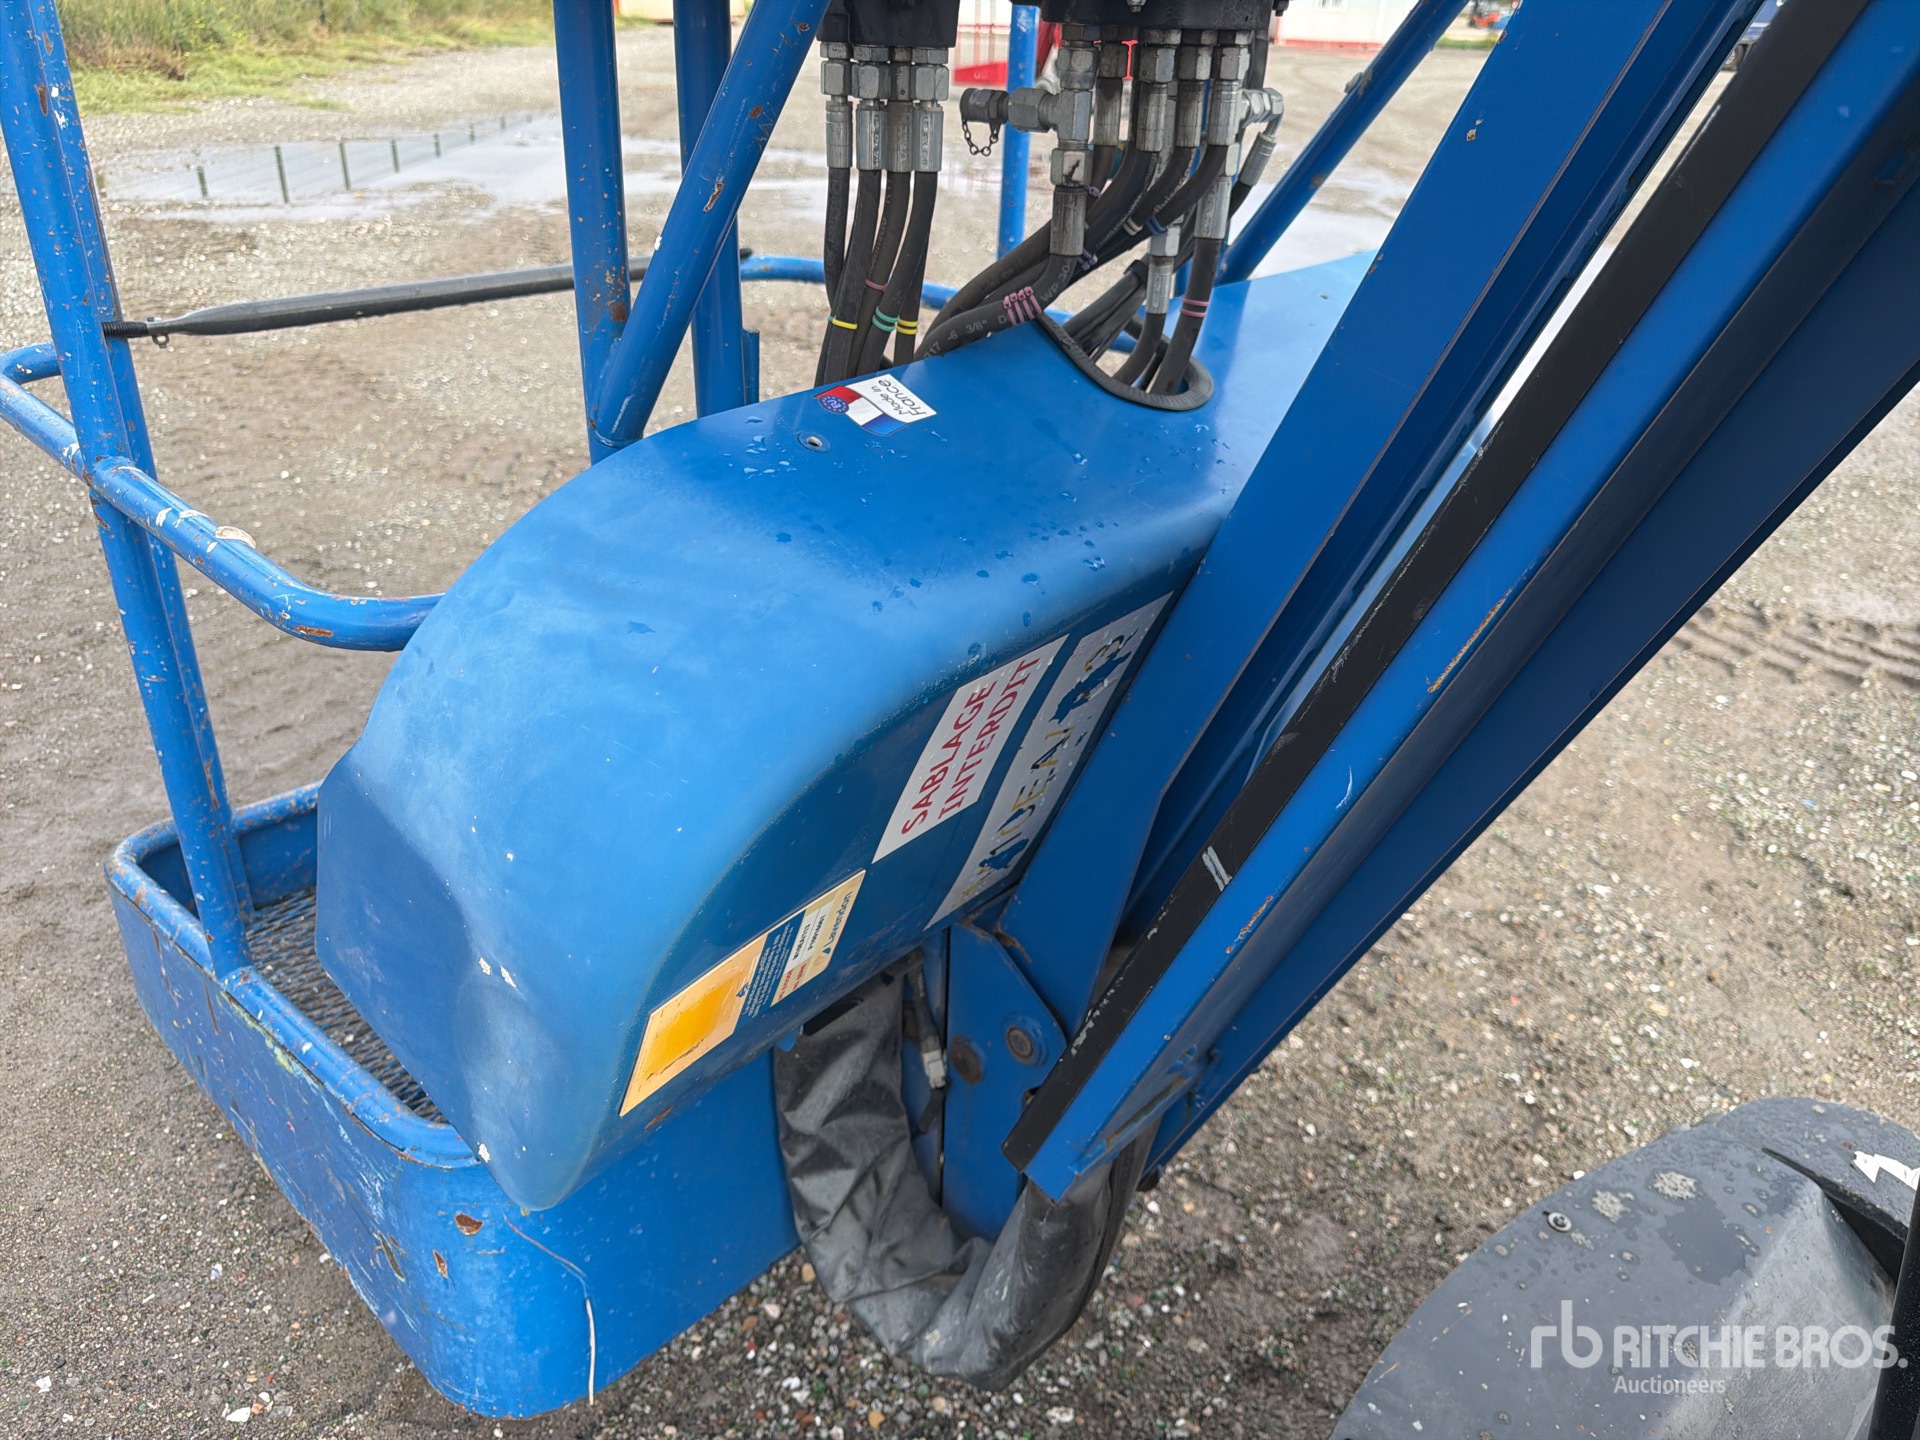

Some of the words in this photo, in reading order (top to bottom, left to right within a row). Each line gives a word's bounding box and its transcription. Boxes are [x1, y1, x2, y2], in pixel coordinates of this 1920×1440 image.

[878, 378, 927, 417] France
[879, 392, 904, 416] Made
[901, 680, 998, 835] SABLAGE
[937, 657, 1040, 822] INTERDIT
[822, 890, 853, 948] Lavendon
